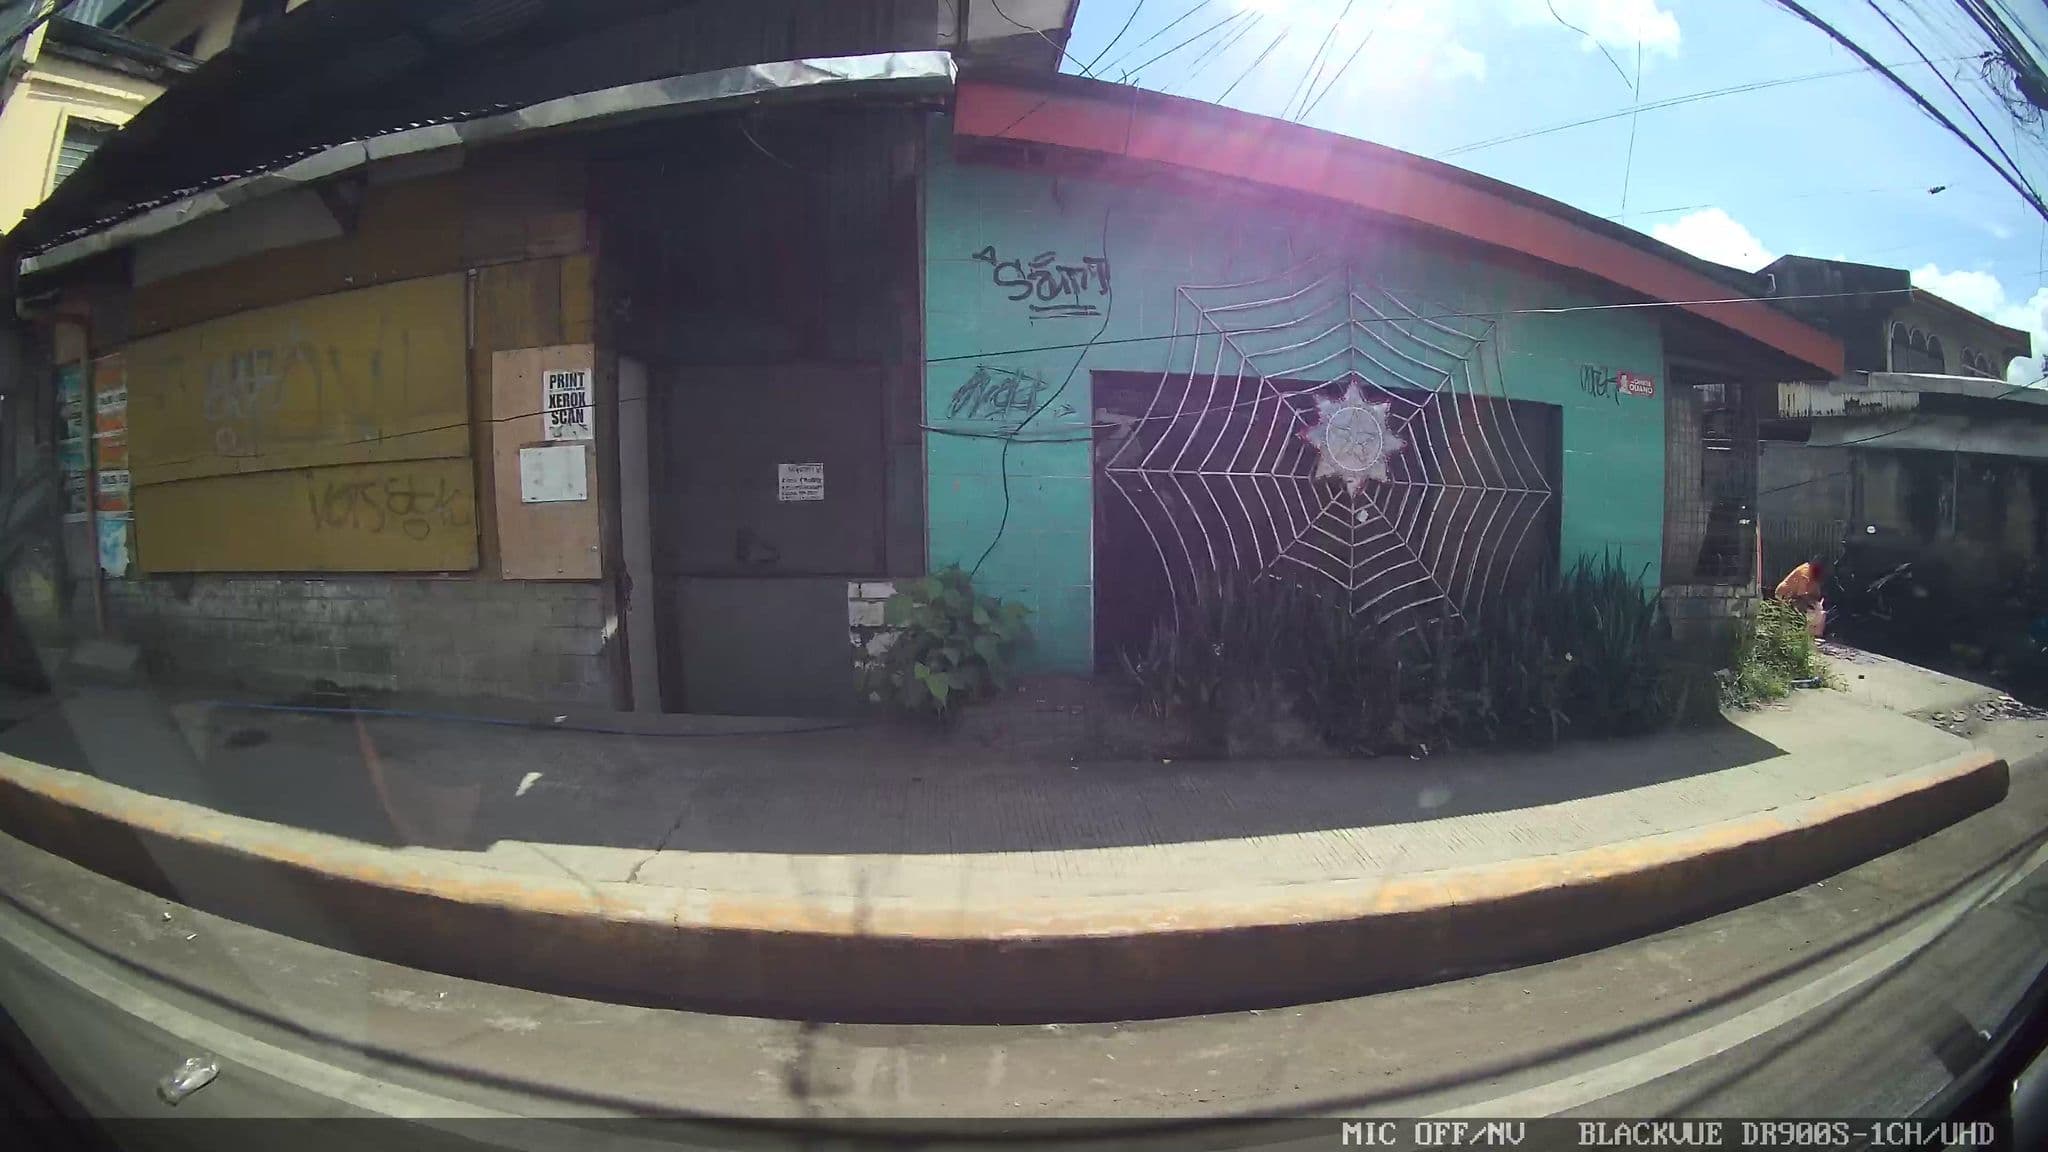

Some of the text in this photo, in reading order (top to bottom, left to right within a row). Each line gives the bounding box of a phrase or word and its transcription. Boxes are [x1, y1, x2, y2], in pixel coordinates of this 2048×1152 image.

[550, 372, 585, 389] PRINT
[549, 392, 585, 408] XEROX
[551, 408, 584, 425] SCAN
